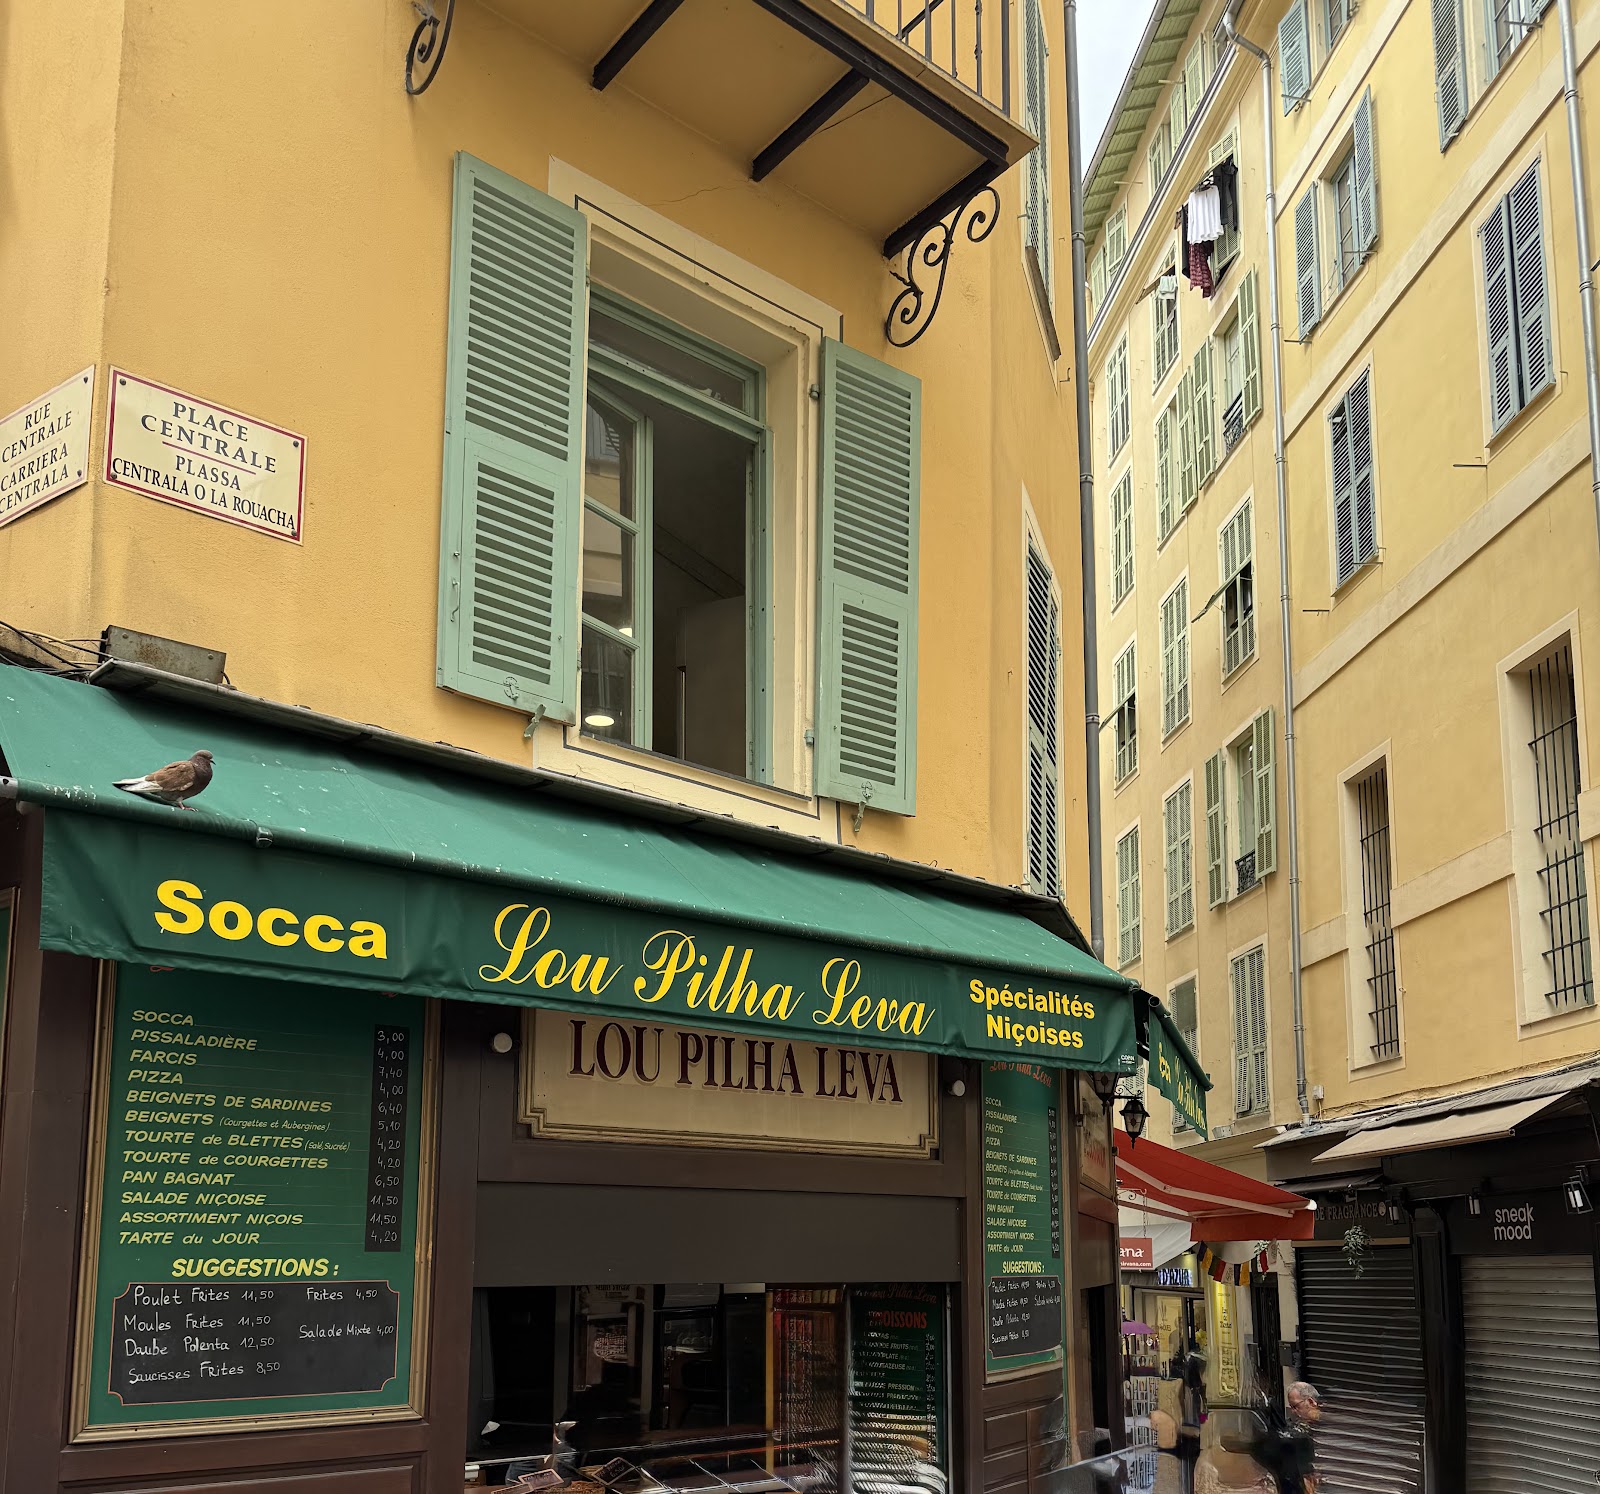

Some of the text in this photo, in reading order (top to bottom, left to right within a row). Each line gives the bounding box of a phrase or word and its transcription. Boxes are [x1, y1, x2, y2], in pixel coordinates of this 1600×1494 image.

[25, 403, 51, 431] RUE
[173, 402, 249, 442] PLACE
[2, 411, 72, 463] CENTRALE
[141, 414, 277, 474] CENTRALE
[0, 442, 69, 492] CARRIERA
[175, 455, 241, 491] PLASSA
[0, 464, 69, 514] CENTRALA
[112, 457, 296, 530] CENTRALA O LA ROUACHA
[154, 879, 389, 960] Socca
[478, 903, 937, 1036] Lou Pilha Leva
[969, 978, 1096, 1020] Spécialités
[131, 1009, 194, 1026] SOCCA
[130, 1029, 258, 1051] PISSALADIÈRE
[377, 1030, 405, 1045] 3,00
[987, 1013, 1084, 1049] Niçoises
[129, 1049, 197, 1066] FARCIS
[377, 1049, 405, 1062] 4,00
[567, 1018, 904, 1104] LOU PILHA LEVA
[127, 1069, 184, 1085] PIZZA
[378, 1065, 403, 1080] 7,40
[379, 1083, 405, 1099] 4,00
[125, 1090, 333, 1113] BEIGNETS DE SARDINES
[377, 1102, 403, 1115] 6,40
[985, 1096, 1002, 1107] SOCCA
[124, 1109, 215, 1126] BEIGNETS
[270, 1120, 279, 1128] et
[124, 1130, 195, 1145] TOURTE
[202, 1133, 223, 1146] de
[227, 1134, 304, 1149] BLETTES
[377, 1138, 401, 1152] 4,20
[122, 1150, 329, 1169] TOURTE de COURGETTES
[377, 1156, 401, 1170] 4,20
[121, 1171, 235, 1187] PAN BAGNAT
[374, 1174, 400, 1188] 6,50
[121, 1191, 267, 1207] SALADE NIÇOISE
[370, 1195, 400, 1207] 11,50
[119, 1211, 304, 1227] ASSORTIMENT NIÇOIS
[369, 1213, 398, 1226] 11,50
[1494, 1202, 1535, 1223] sneak
[118, 1231, 261, 1245] TARTE du JOUR
[370, 1231, 398, 1244] 4,20
[1493, 1222, 1532, 1240] mood
[133, 1285, 183, 1307] Poulet
[241, 1289, 275, 1303] 11,50
[355, 1289, 378, 1301] 4,50
[124, 1311, 172, 1332] Moules
[237, 1314, 272, 1328] 11,50
[299, 1323, 395, 1340] Salade Mixte 4,00
[125, 1336, 275, 1357] Daube Polenta 12,50
[128, 1368, 191, 1385] Saucisses
[256, 1361, 281, 1375] 8,50
